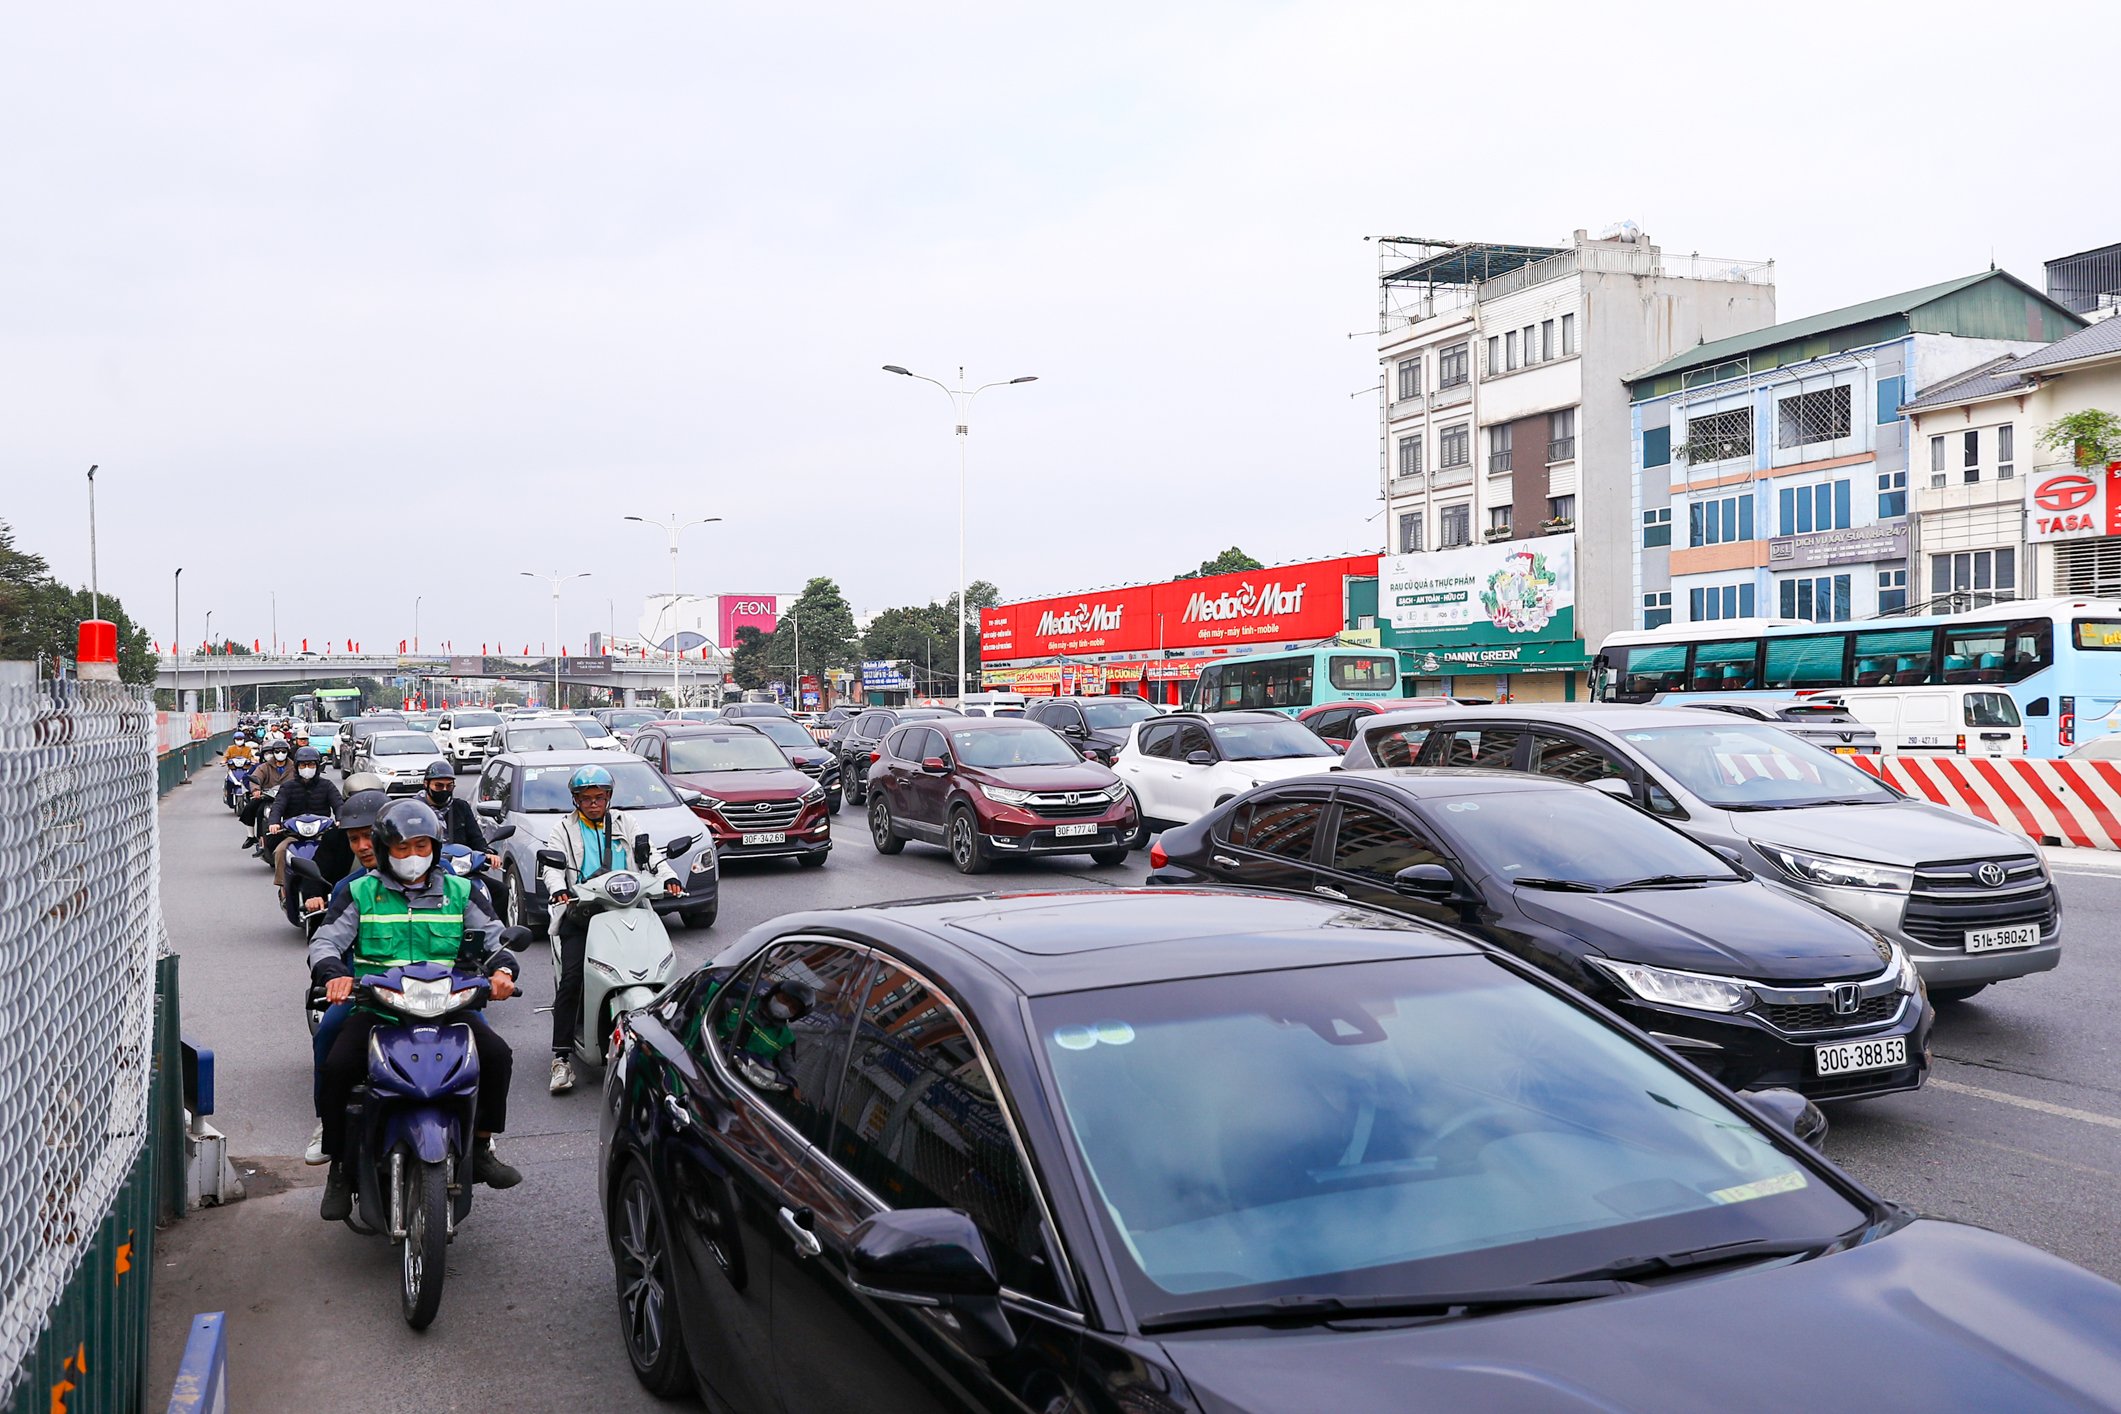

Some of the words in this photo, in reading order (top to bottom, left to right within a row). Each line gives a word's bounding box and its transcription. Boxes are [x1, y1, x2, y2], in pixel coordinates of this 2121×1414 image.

[2036, 514, 2094, 534] TASA
[1390, 584, 1404, 592] RAU
[1257, 623, 1279, 634] mobile
[1444, 651, 1479, 661] DANNY
[1480, 649, 1518, 660] GREEN
[1819, 1040, 1904, 1072] 30G-388.53
